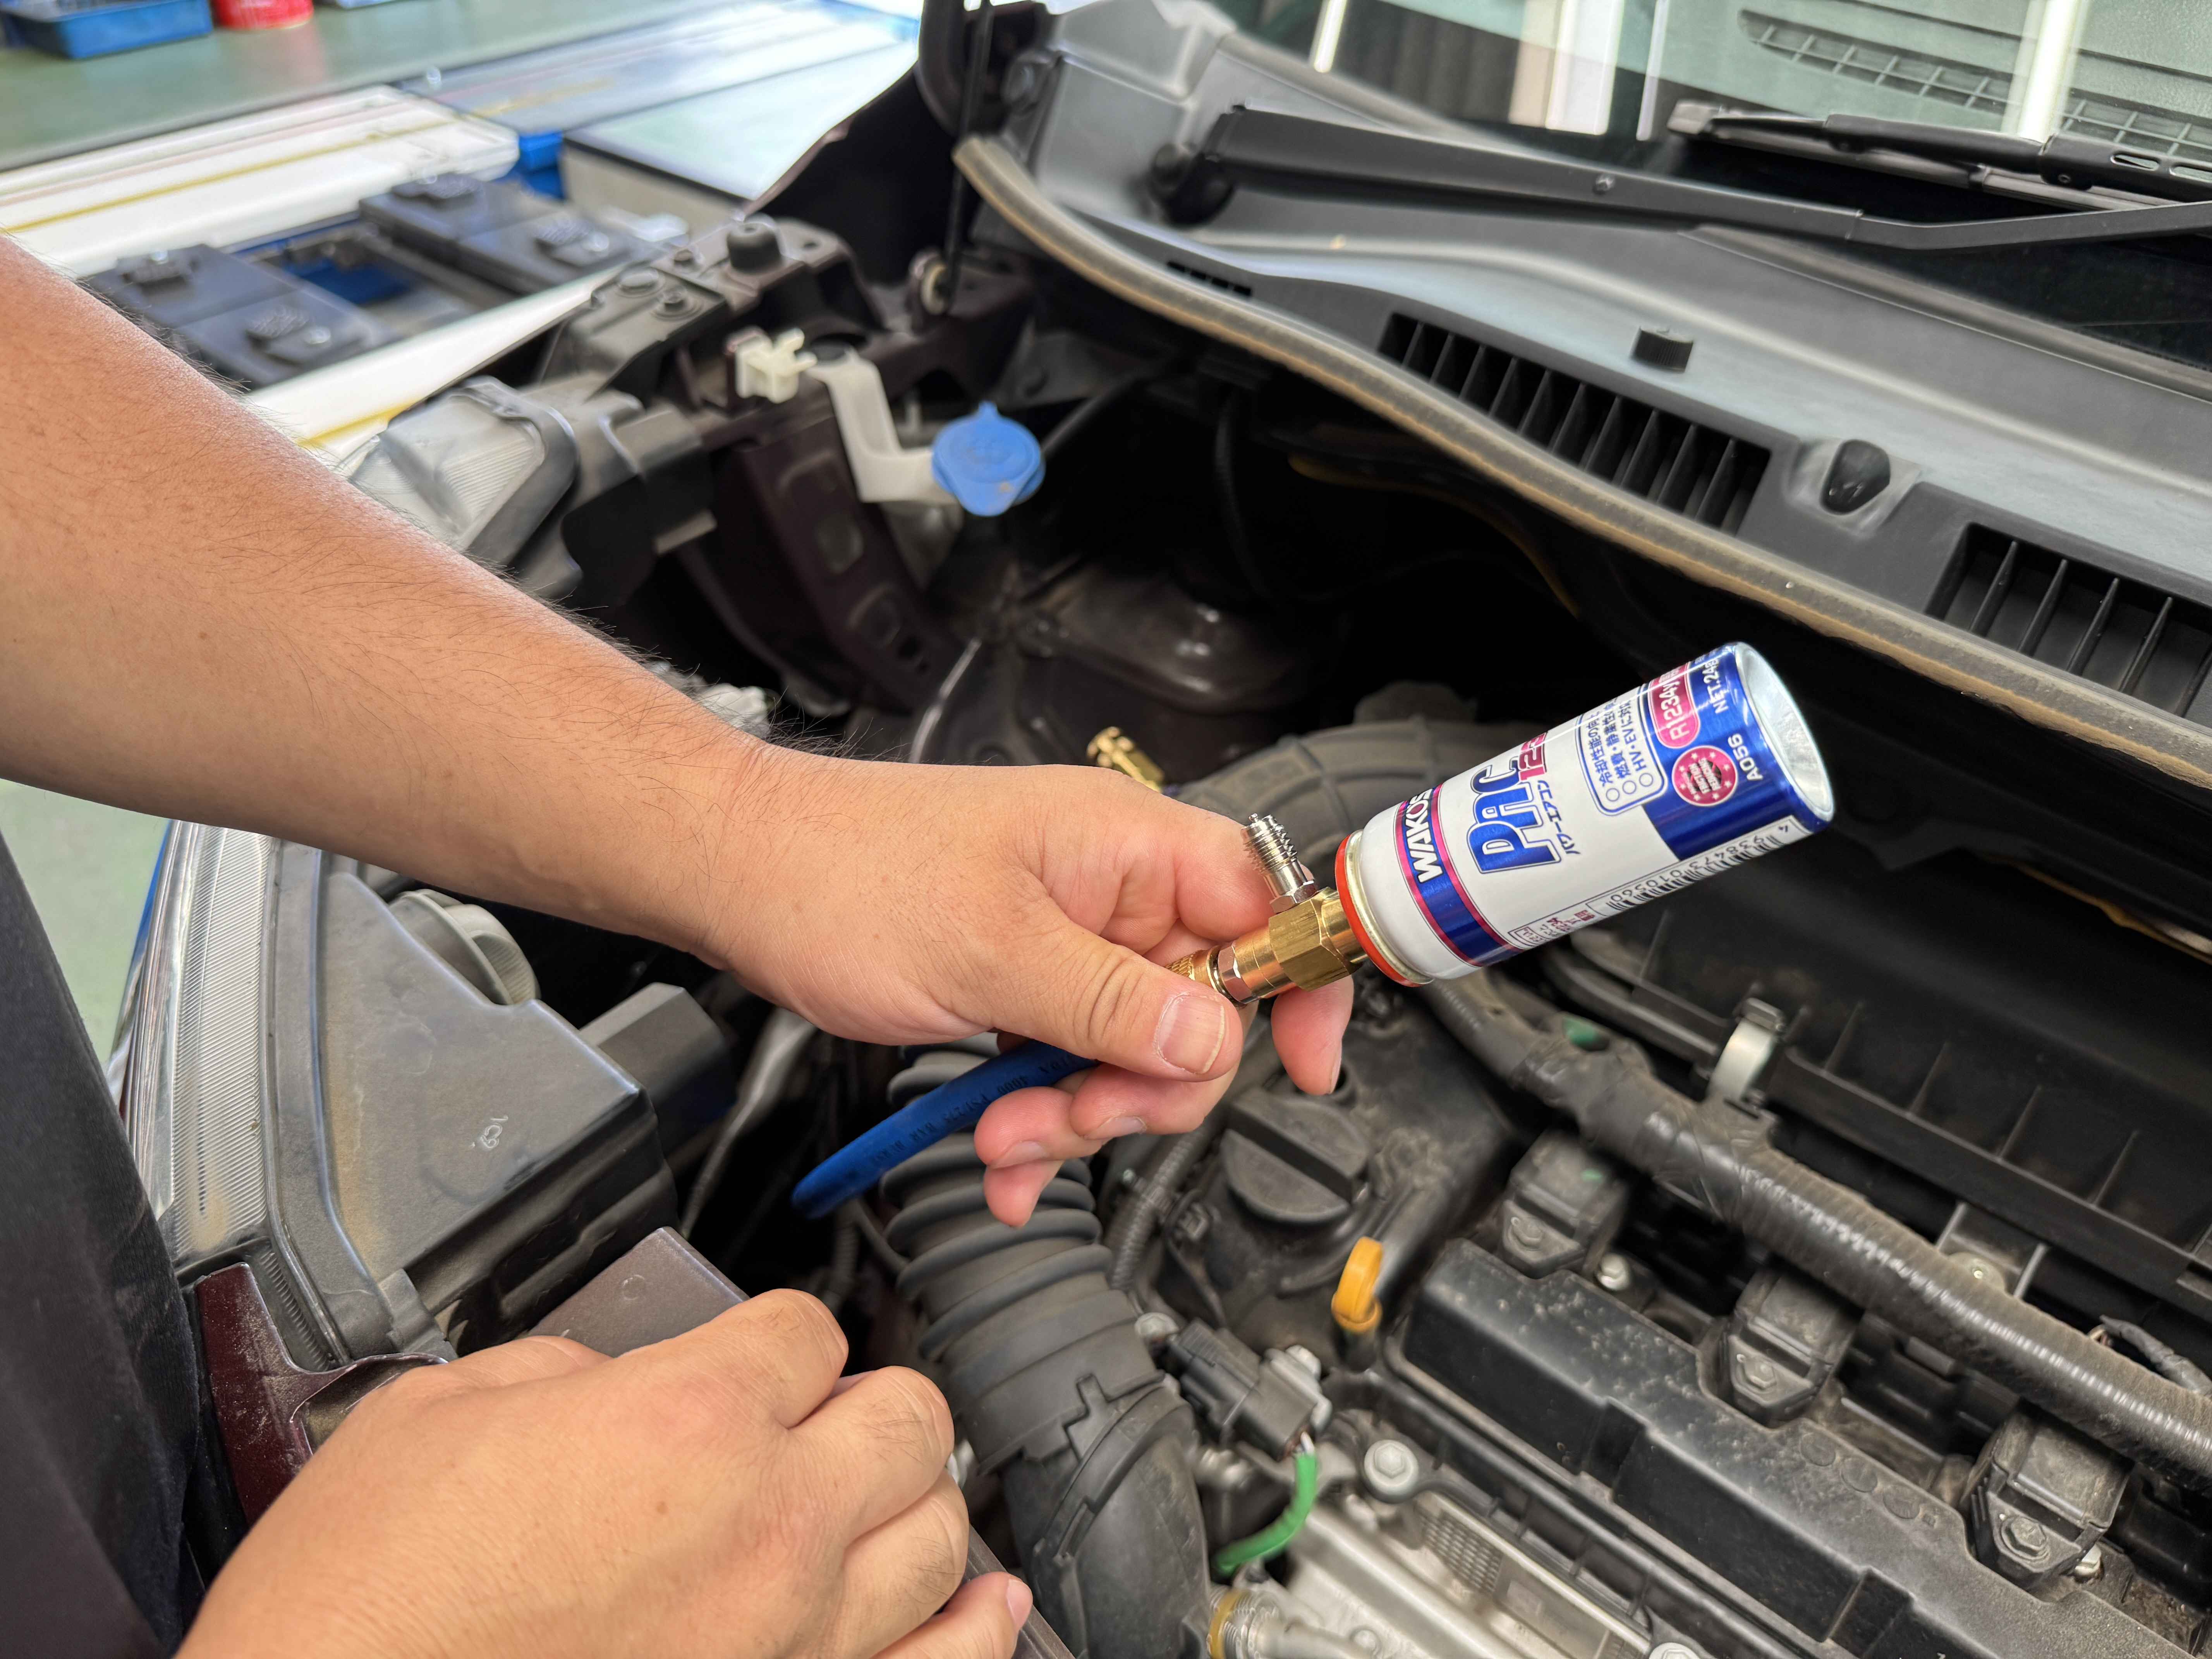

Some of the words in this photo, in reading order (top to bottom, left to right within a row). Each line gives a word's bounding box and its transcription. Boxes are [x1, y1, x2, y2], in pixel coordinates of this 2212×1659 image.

[1659, 680, 1690, 740] R1234y
[1728, 733, 1763, 781] A056
[1537, 780, 1581, 855] パワーエアコン
